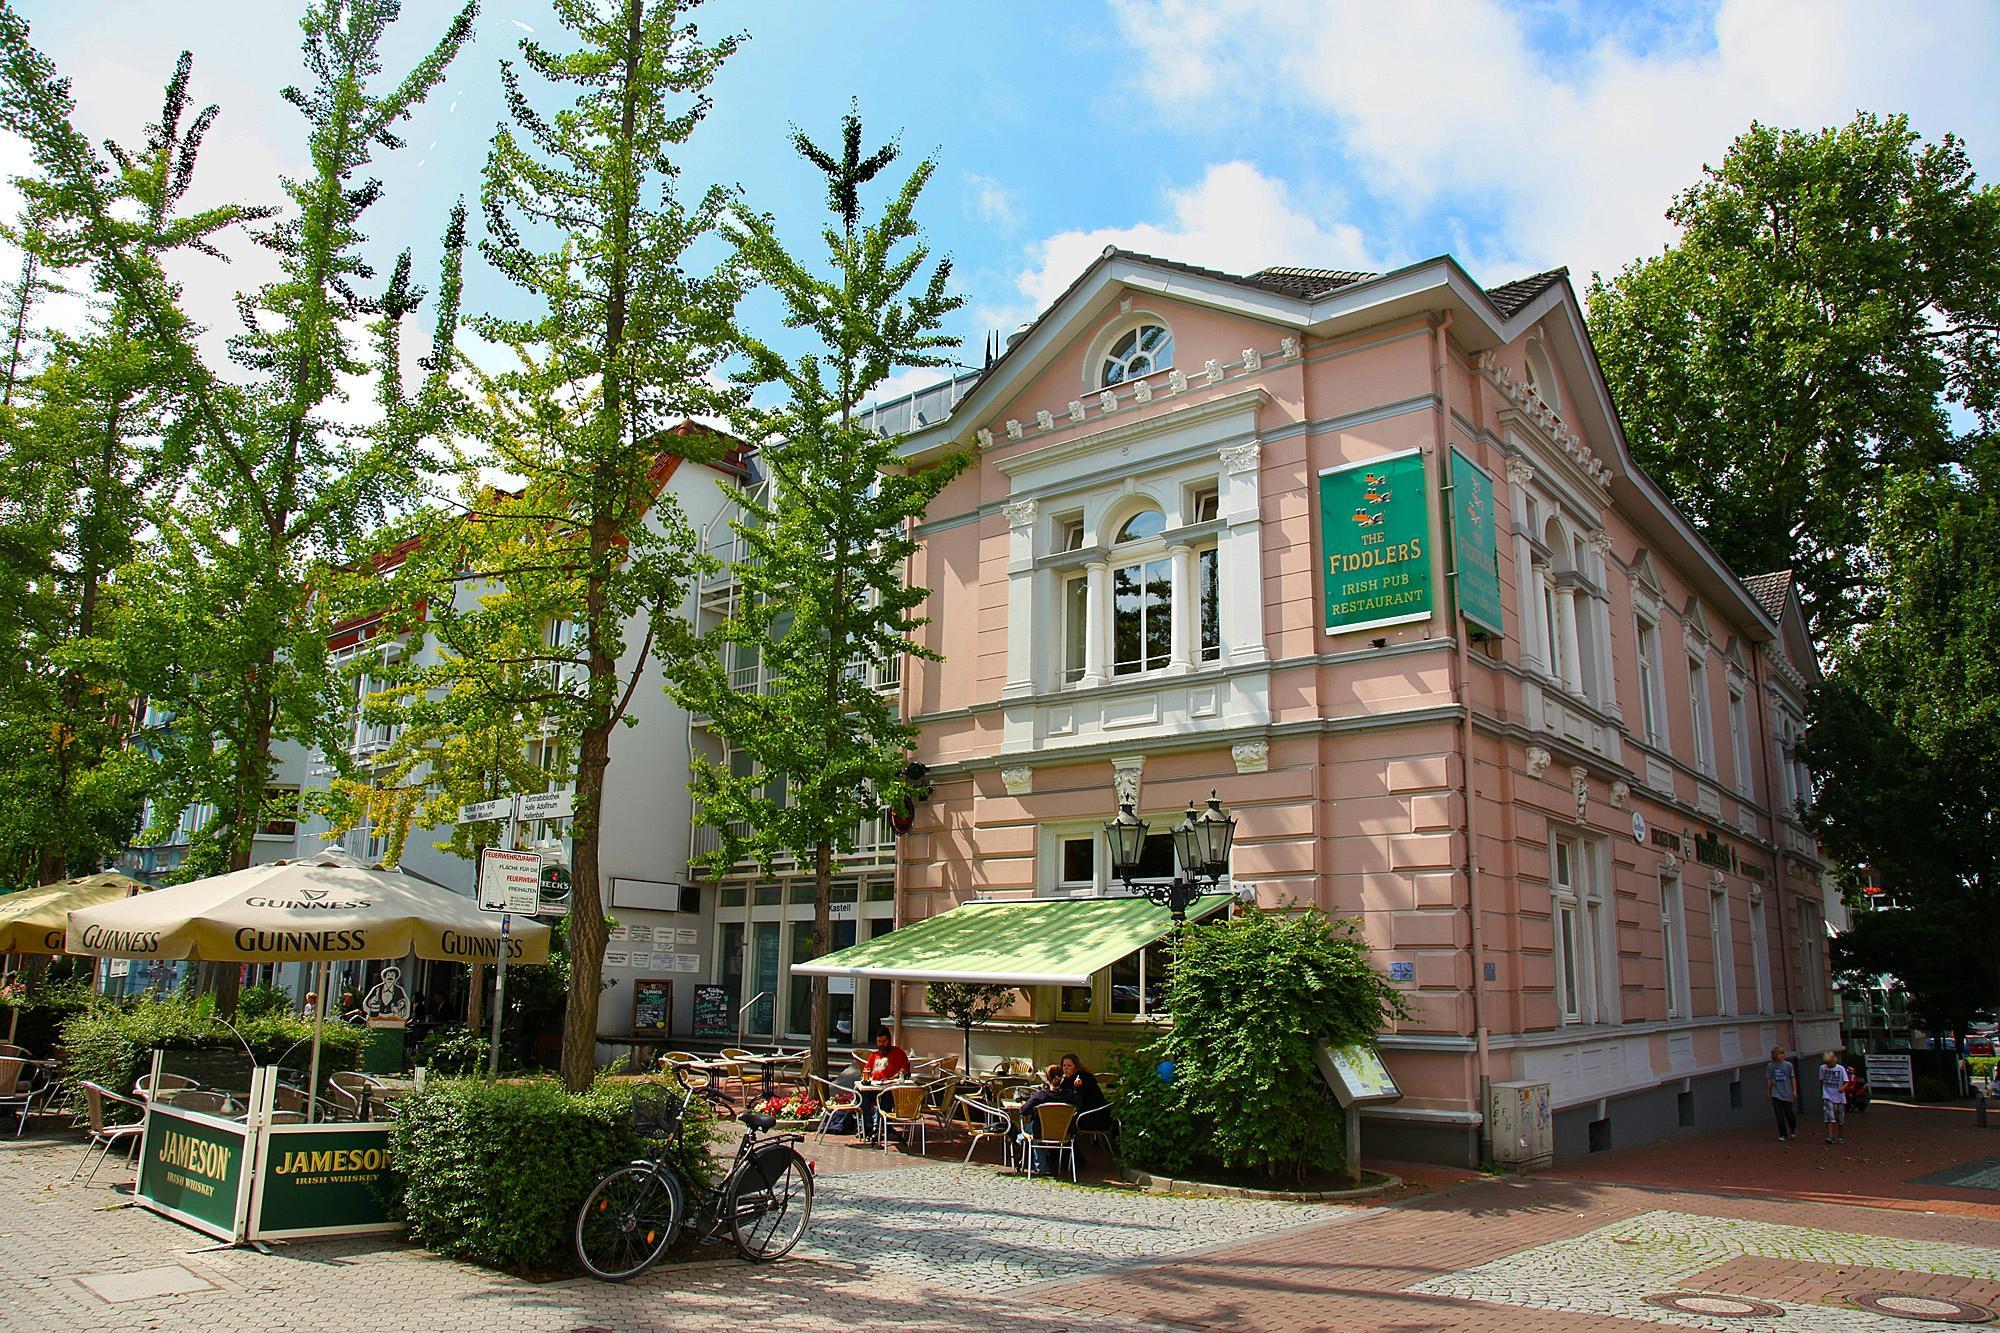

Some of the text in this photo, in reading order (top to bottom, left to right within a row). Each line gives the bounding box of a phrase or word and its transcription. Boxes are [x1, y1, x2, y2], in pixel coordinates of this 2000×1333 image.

[1361, 532, 1384, 546] THE
[1329, 538, 1421, 575] FIDDLERS
[1342, 573, 1409, 596] IRISH PUB
[1332, 589, 1423, 616] RESTAURANT
[526, 793, 560, 803] Zentralbibliothek
[524, 802, 558, 811] Halle Adolfinum
[485, 851, 540, 863] FEUERWEHRZUFAHRT
[499, 864, 518, 872] FLÄCHE
[506, 875, 538, 884] FEUERWEHR
[508, 886, 537, 894] FREIHALTEN
[246, 896, 372, 909] GUINNESS
[829, 903, 851, 912] Kastell
[82, 924, 160, 953] GUINNESS
[234, 927, 366, 951] GUINNESS
[441, 930, 523, 958] GUINNSS
[159, 1130, 230, 1181] JAMESON
[167, 1172, 215, 1197] IRISH WHISKEY
[295, 1174, 380, 1185] IRISH WHISKEY
